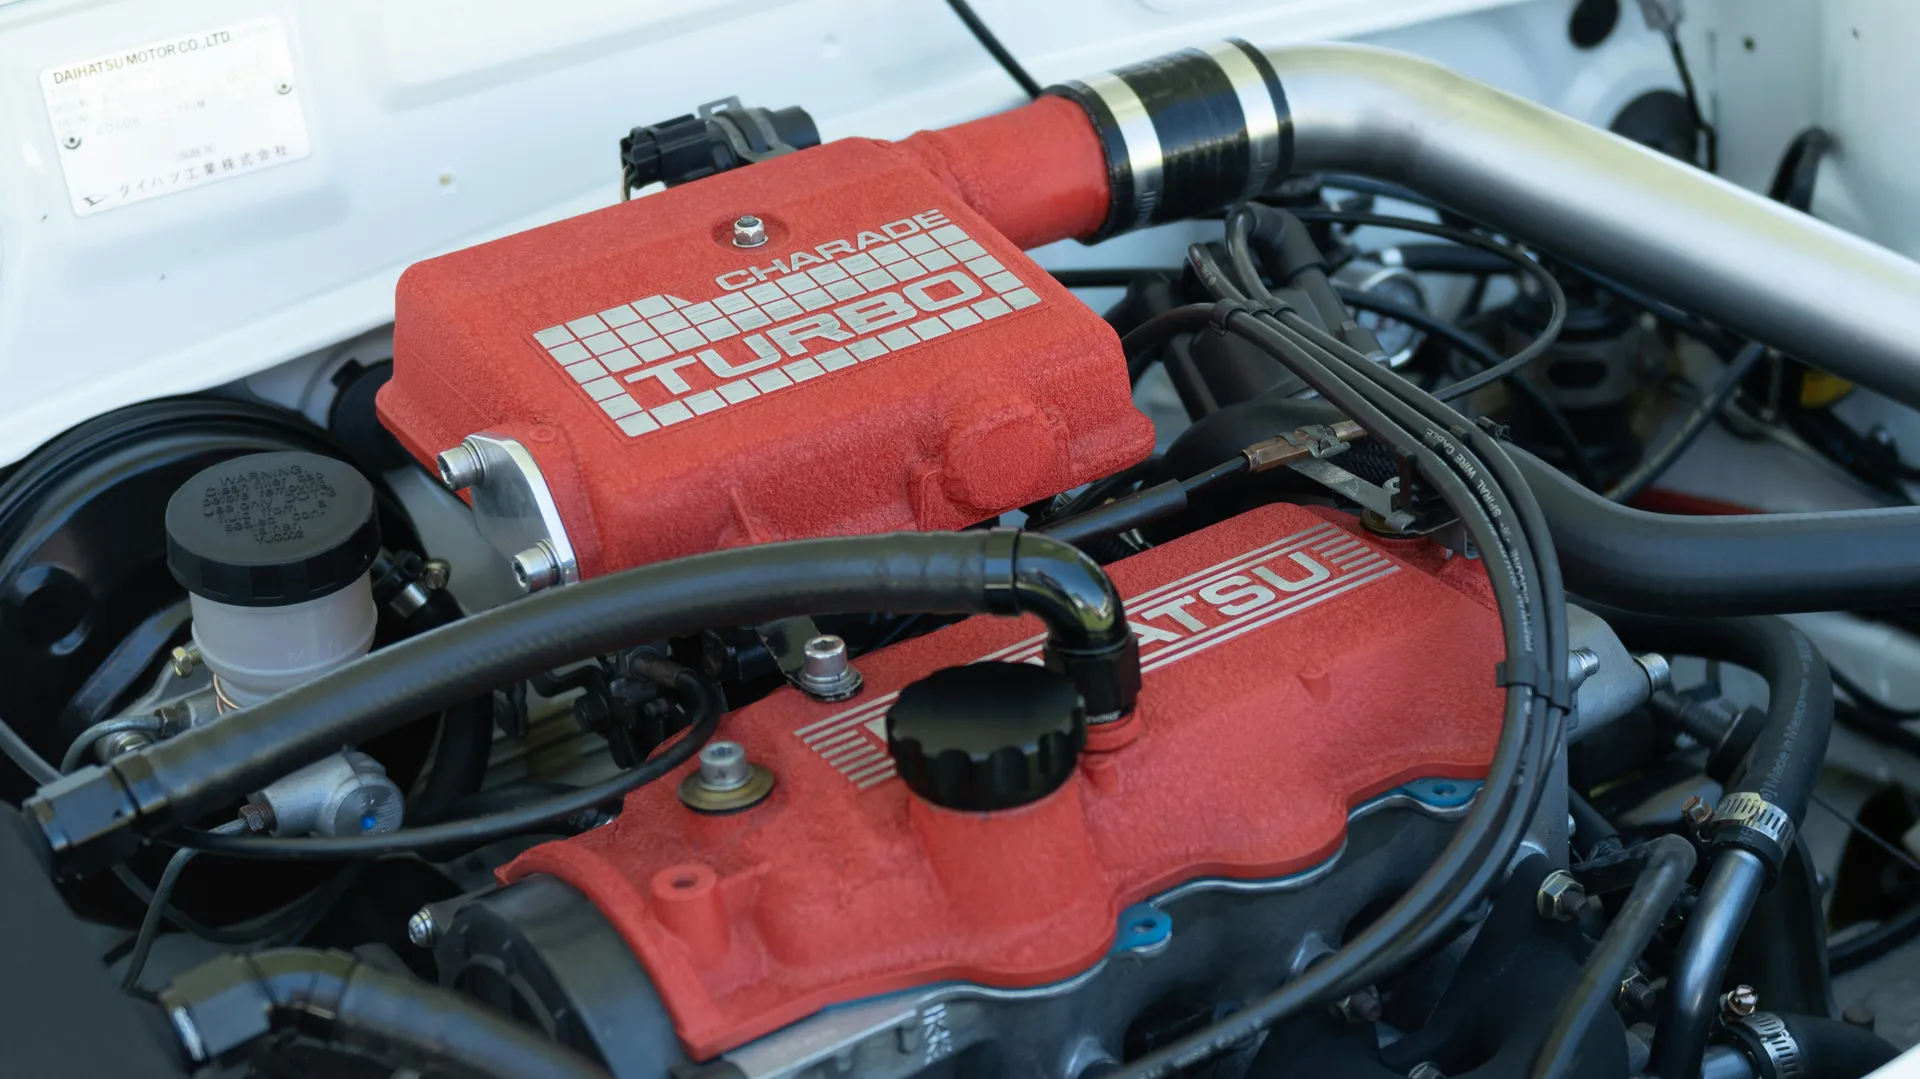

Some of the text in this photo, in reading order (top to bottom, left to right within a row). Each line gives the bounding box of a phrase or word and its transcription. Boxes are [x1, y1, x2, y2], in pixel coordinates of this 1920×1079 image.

[53, 58, 124, 85] DAIHATSU
[126, 44, 177, 66] MOTOR
[119, 143, 288, 199] ダイハツ工業株式会社
[715, 208, 951, 291] CHARADE
[624, 271, 983, 395] TURBO
[1455, 453, 1477, 480] WIRE
[1477, 479, 1502, 518] SPIRAL
[1766, 751, 1790, 790] Made
